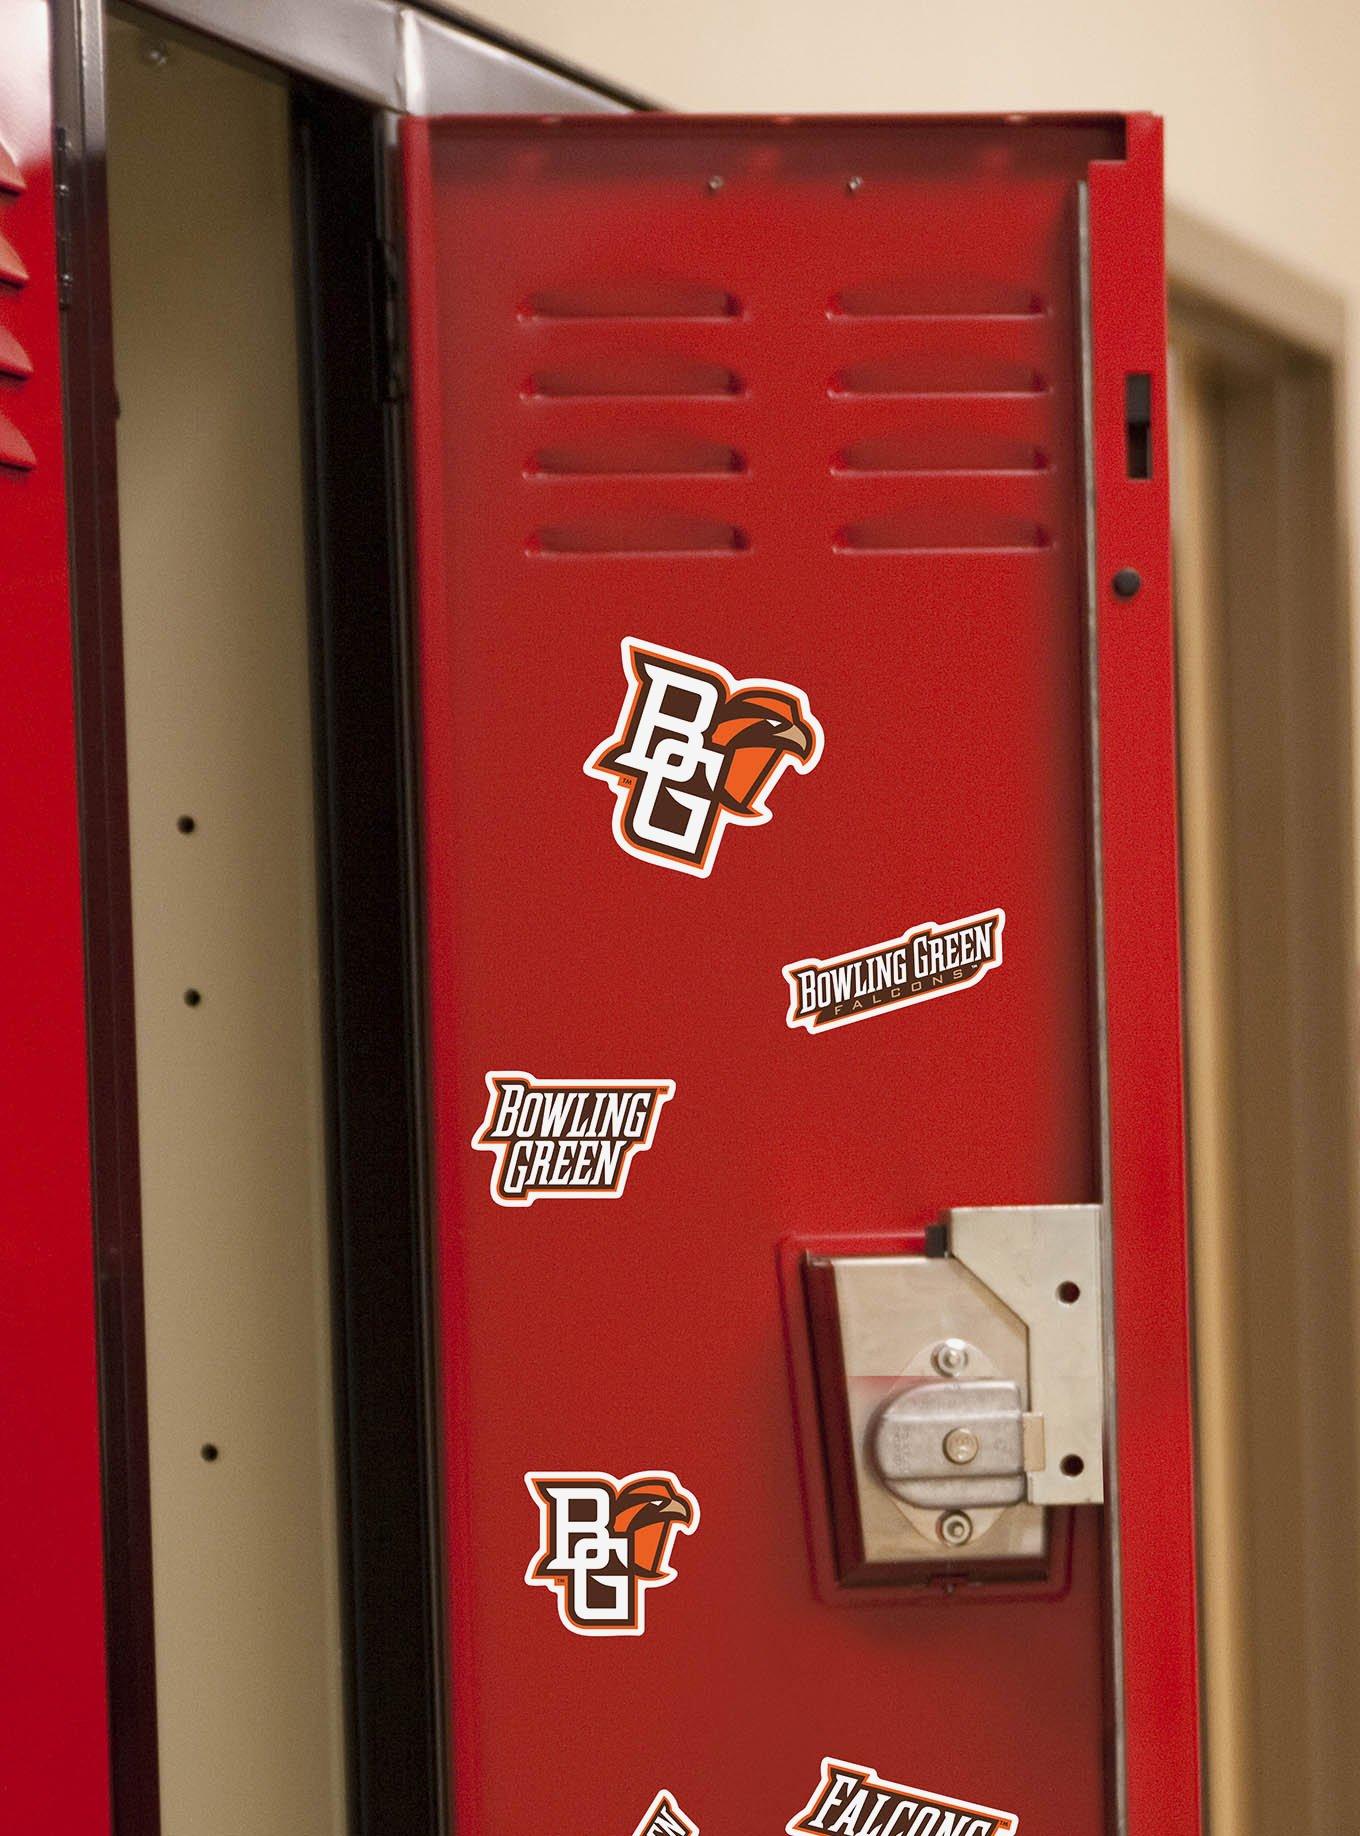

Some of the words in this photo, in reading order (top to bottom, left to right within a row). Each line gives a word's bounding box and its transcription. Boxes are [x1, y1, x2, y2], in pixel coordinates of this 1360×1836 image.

[614, 662, 724, 854] BG
[797, 948, 907, 1014] BOWLING
[913, 921, 993, 979] GREEN
[834, 969, 963, 1015] FALCONS
[490, 1084, 651, 1137] BOWLING
[503, 1140, 627, 1193] GREEN
[546, 1487, 628, 1620] BG
